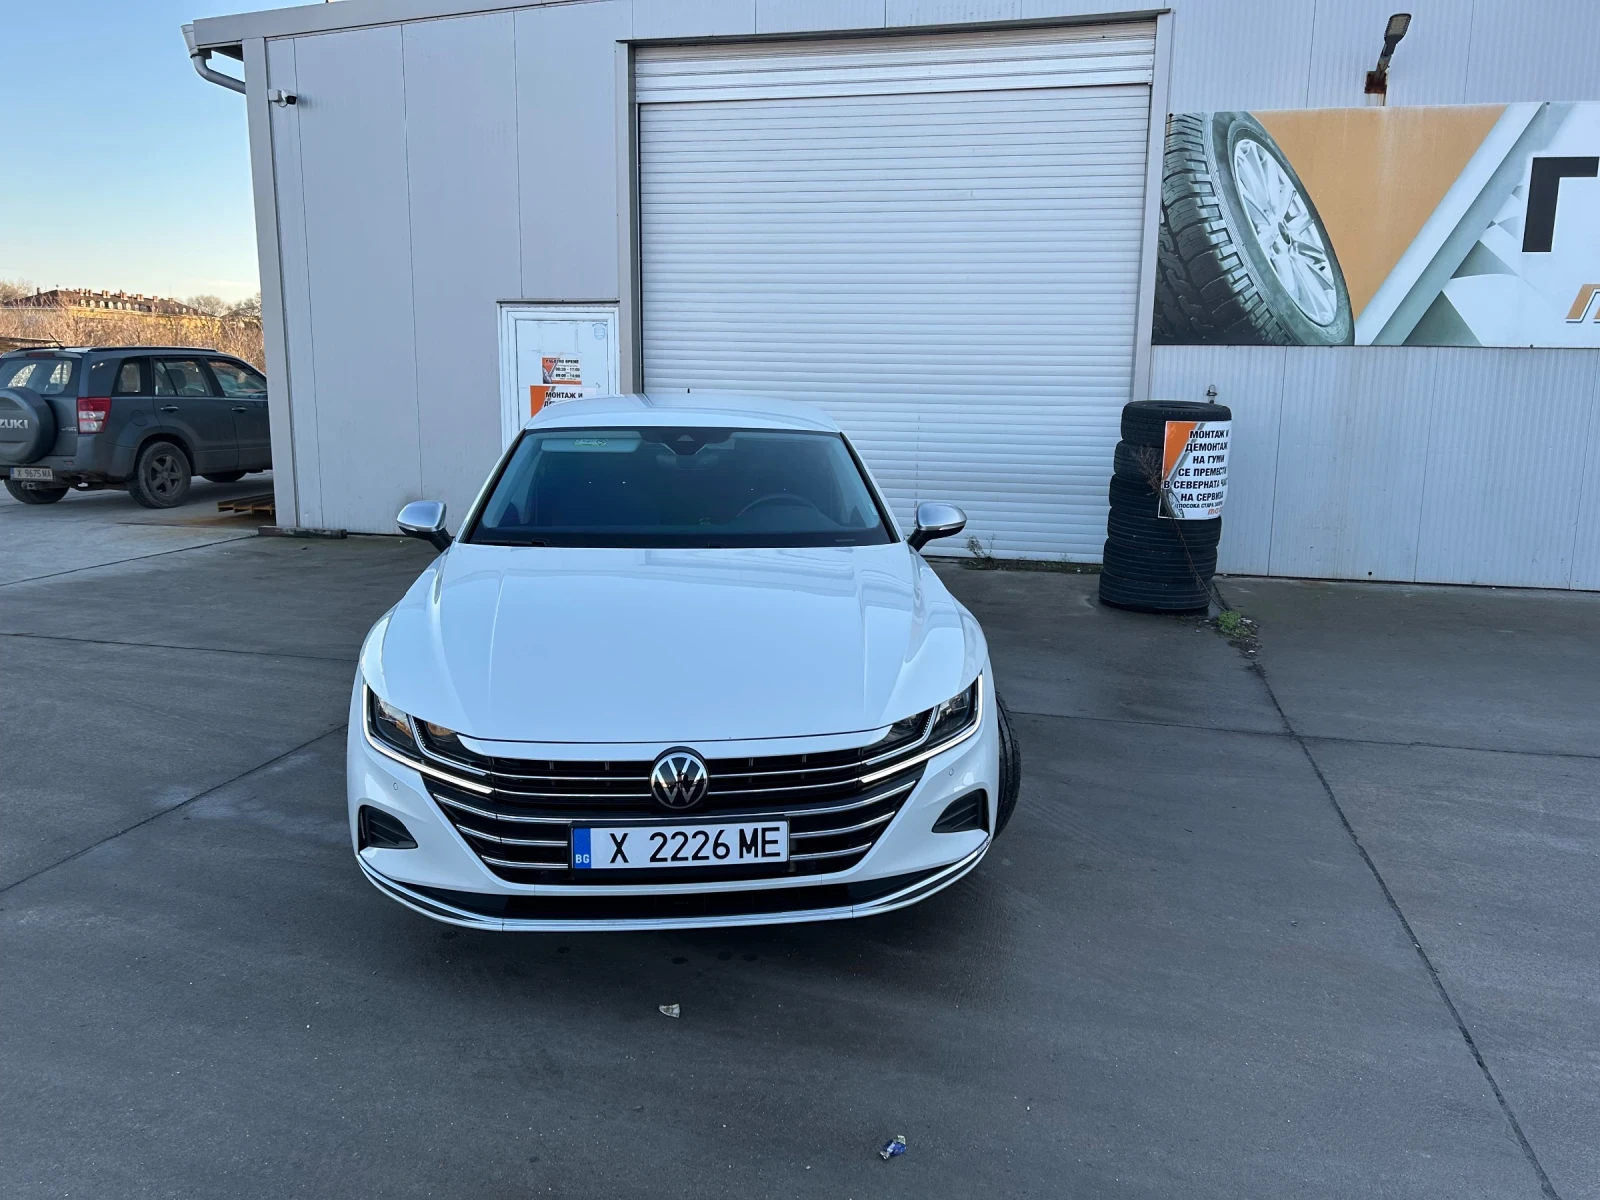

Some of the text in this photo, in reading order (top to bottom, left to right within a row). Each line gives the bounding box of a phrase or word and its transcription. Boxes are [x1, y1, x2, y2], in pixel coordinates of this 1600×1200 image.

[545, 391, 576, 399] МОНТАЖ
[1189, 430, 1225, 439] МОНТАЖ
[1185, 442, 1228, 453] ДЕМОНТАЖ
[1192, 454, 1225, 464] НА ГУМИ
[17, 469, 22, 478] X
[24, 469, 42, 478] 9675
[1178, 468, 1191, 477] СЕ
[1163, 480, 1170, 489] В
[1173, 479, 1220, 489] СЕВЕРНАТА
[1180, 493, 1194, 502] НА
[575, 826, 781, 864] BG X 2226 ME
